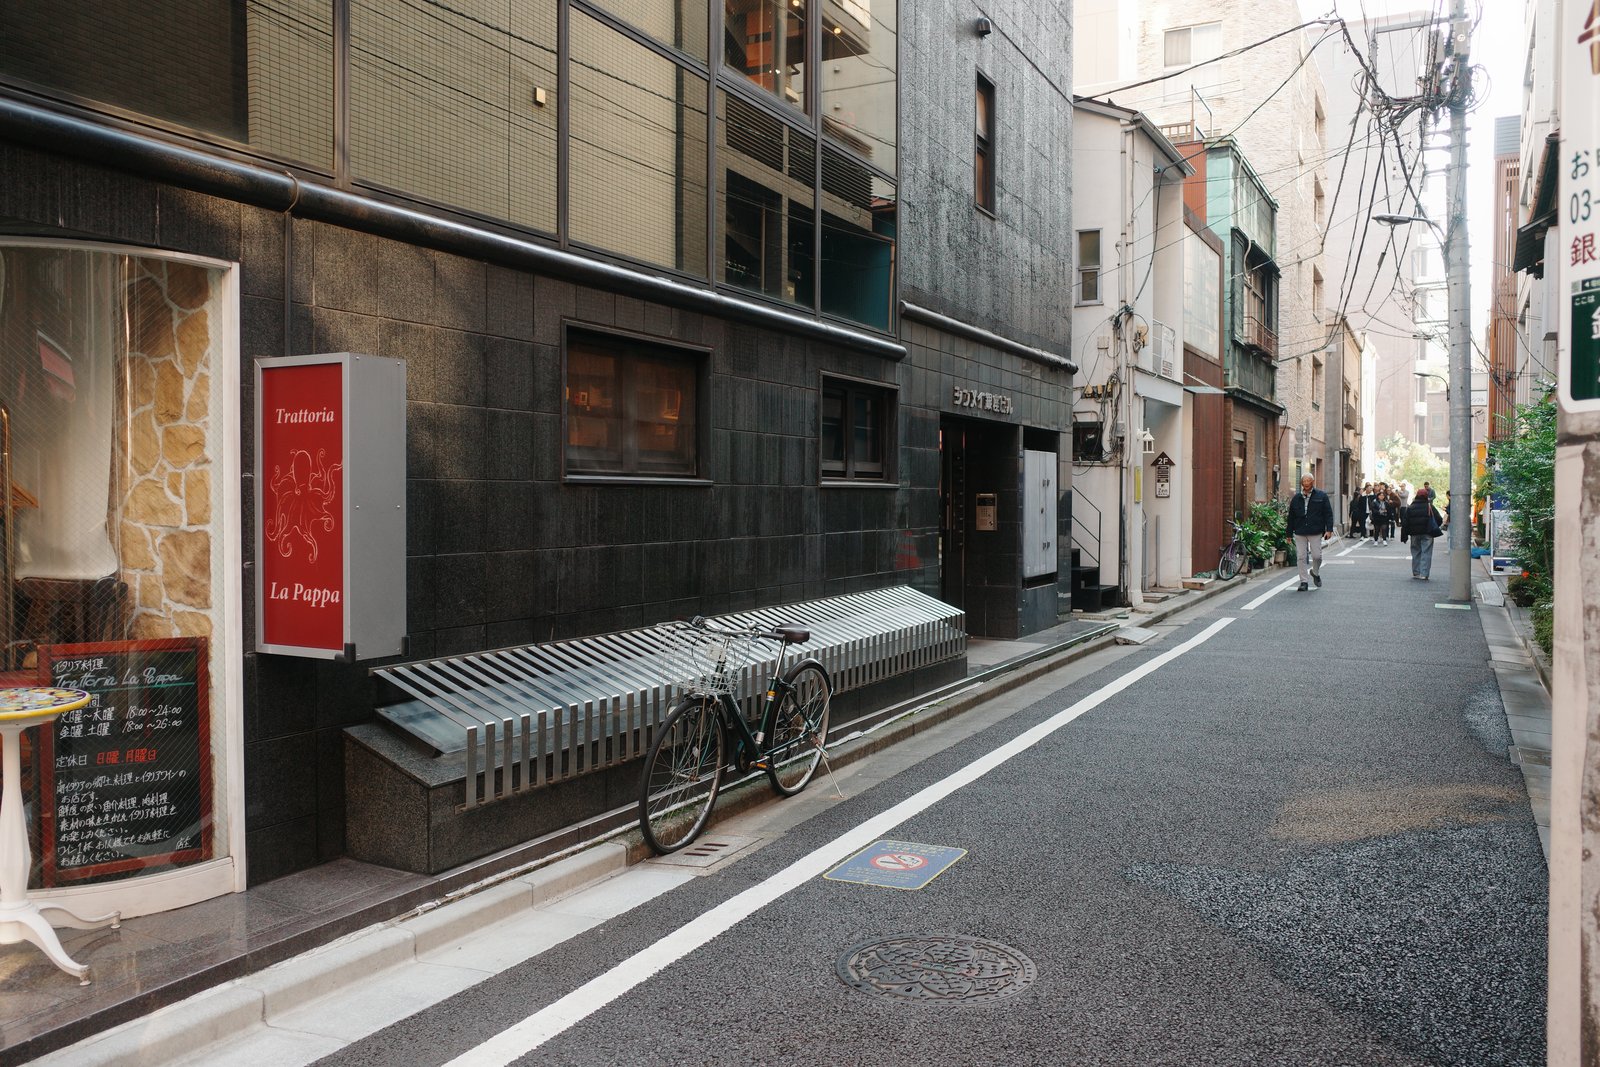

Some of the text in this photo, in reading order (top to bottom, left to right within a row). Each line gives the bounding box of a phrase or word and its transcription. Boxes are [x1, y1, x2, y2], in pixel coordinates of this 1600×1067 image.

[275, 407, 335, 424] Trattoria
[1158, 457, 1169, 465] 2F
[270, 582, 340, 608] La Pappa
[53, 658, 107, 673] イタリア料理
[55, 667, 182, 689] Trattoria La Pappa
[55, 754, 88, 768] 定休日
